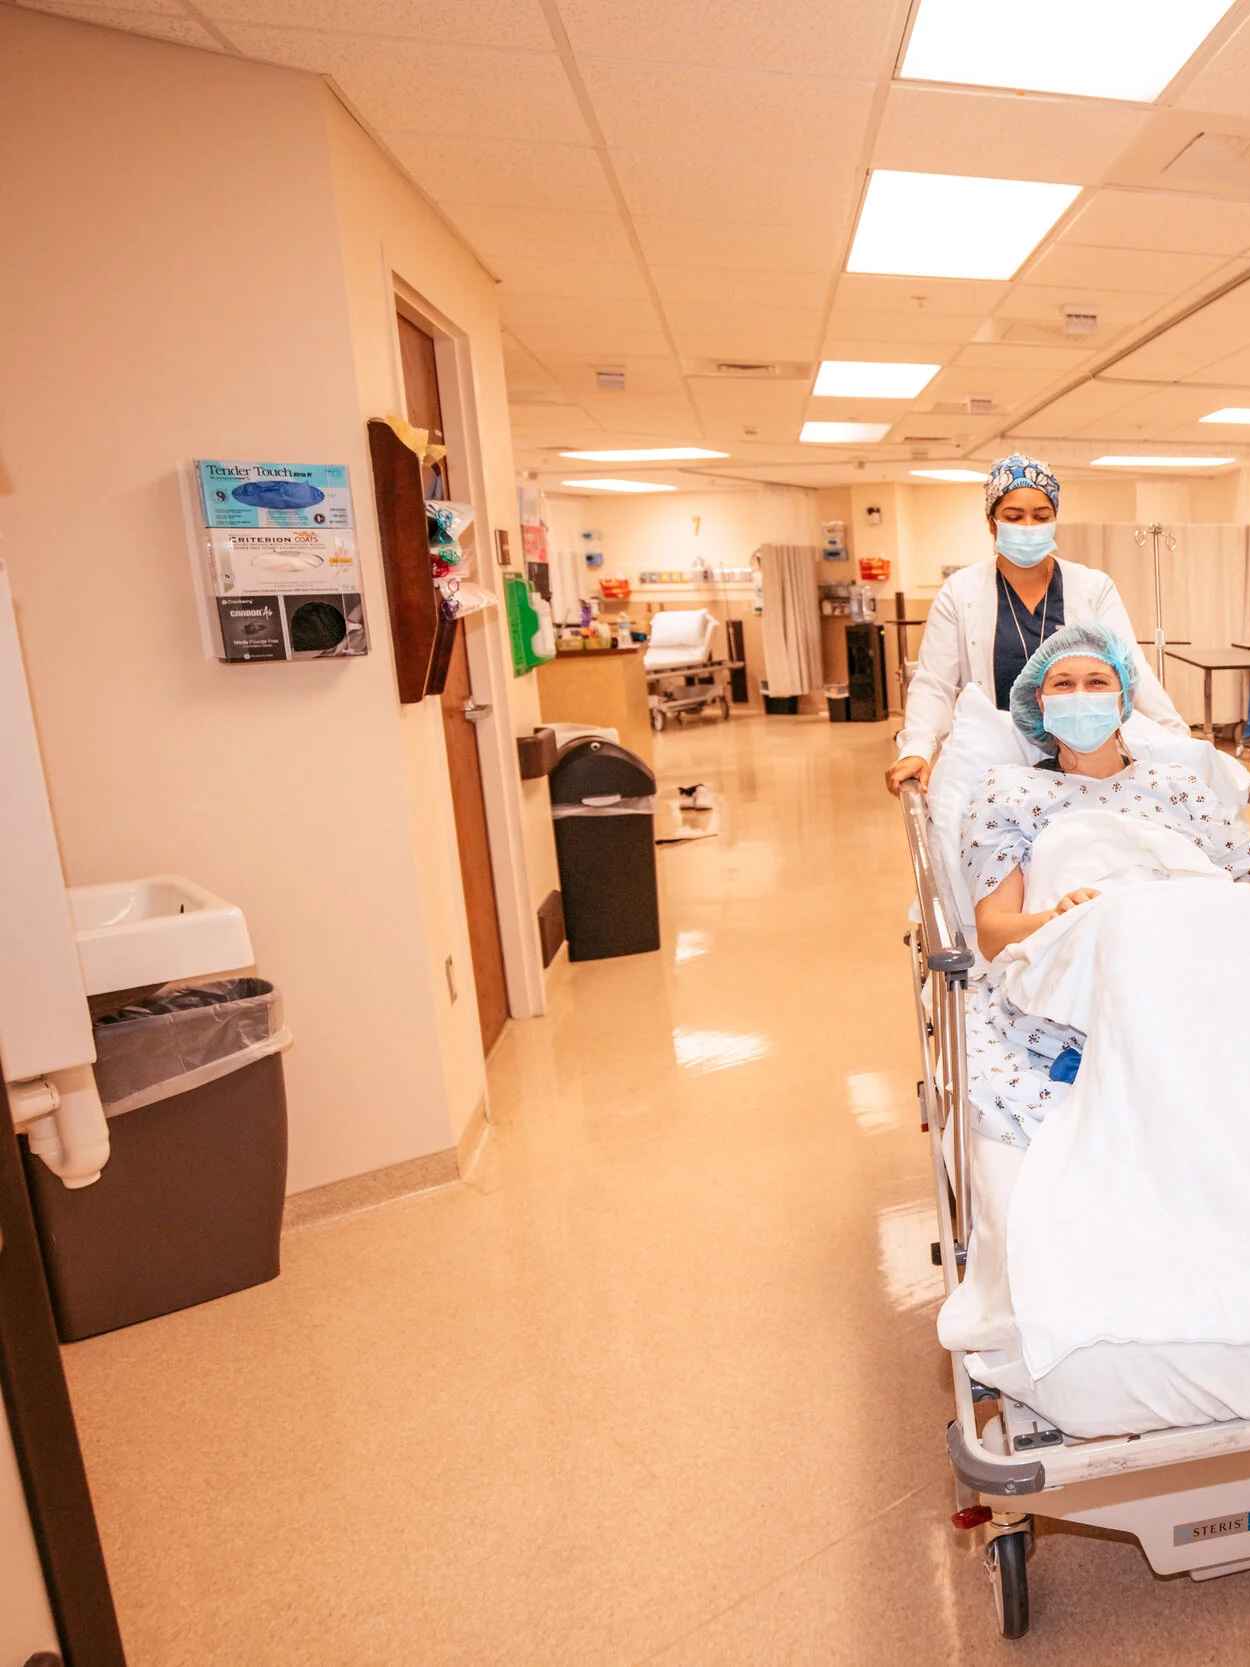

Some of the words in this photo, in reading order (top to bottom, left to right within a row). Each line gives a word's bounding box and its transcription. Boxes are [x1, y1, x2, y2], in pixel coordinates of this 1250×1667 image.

[206, 464, 251, 477] Tender
[253, 466, 293, 478] Touch
[229, 536, 292, 544] CRITERION
[230, 609, 262, 618] CARBON
[1193, 1520, 1242, 1537] STERIS
